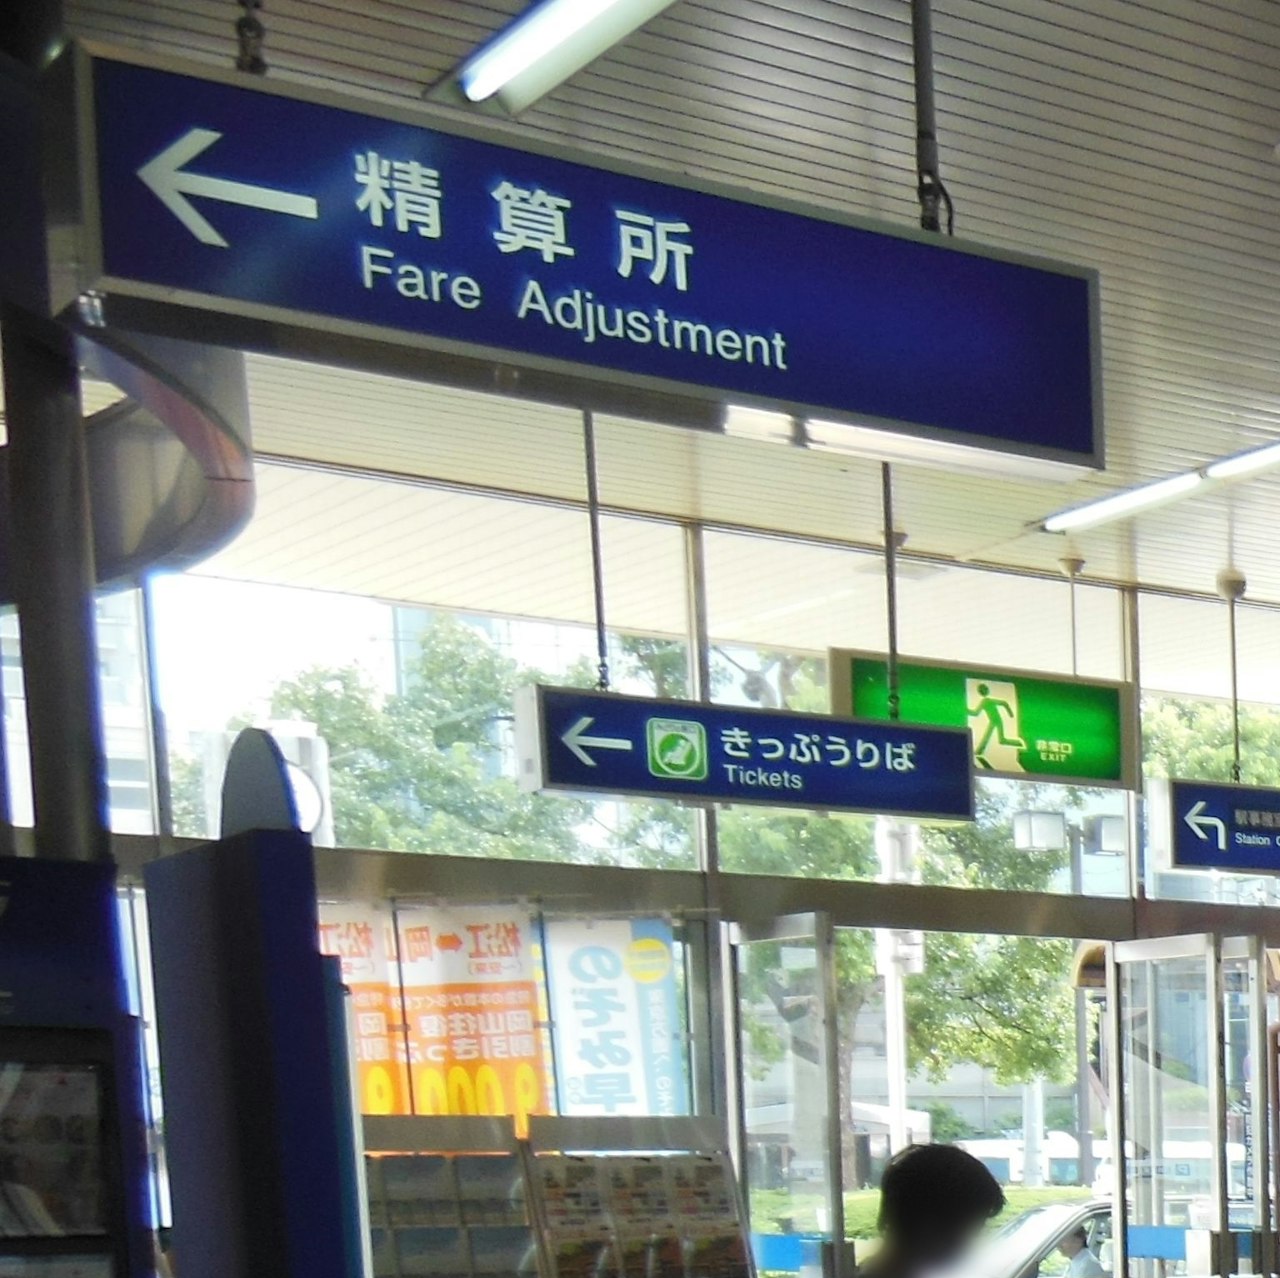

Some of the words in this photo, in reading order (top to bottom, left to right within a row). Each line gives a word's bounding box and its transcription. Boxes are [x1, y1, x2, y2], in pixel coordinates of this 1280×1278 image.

[354, 150, 696, 292] 精算所
[361, 249, 483, 312] Fare
[516, 280, 789, 371] Adjustment
[720, 727, 917, 771] きっぷうりば
[1040, 752, 1066, 762] EXIT
[726, 765, 802, 790] Tickets
[1235, 832, 1270, 846] Station
